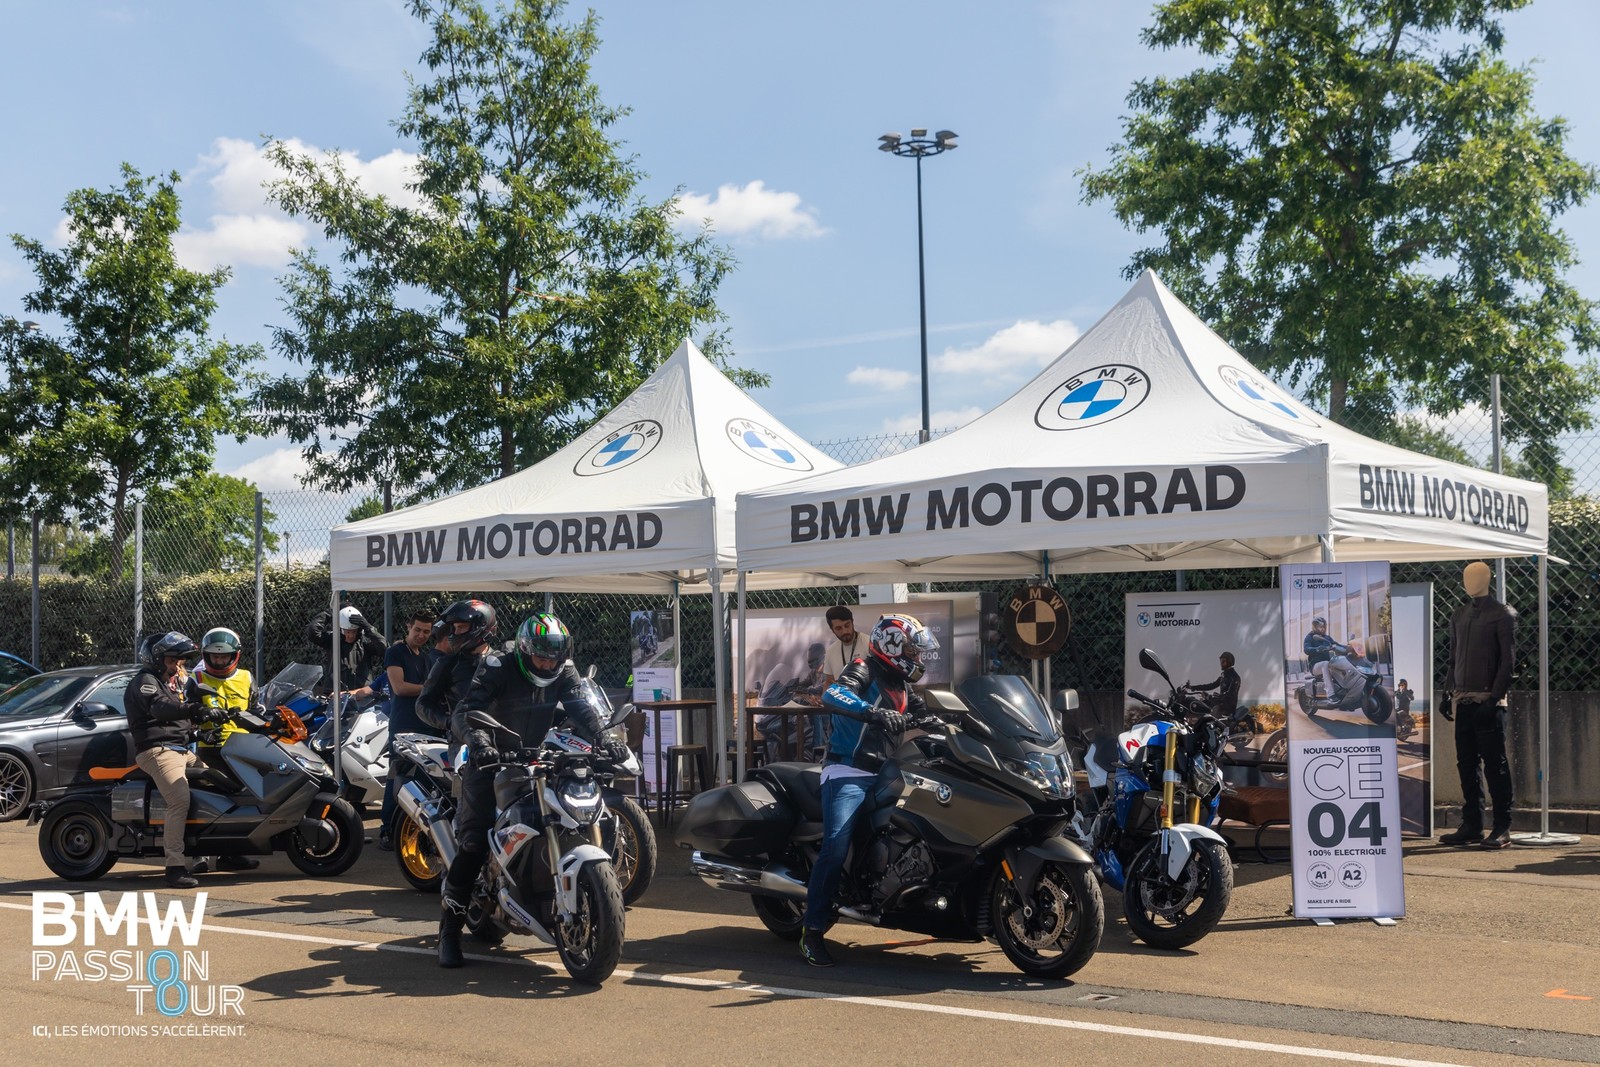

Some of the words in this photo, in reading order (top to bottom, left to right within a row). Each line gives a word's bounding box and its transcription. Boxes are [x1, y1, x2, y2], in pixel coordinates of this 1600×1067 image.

[1065, 368, 1142, 391] BMW
[607, 423, 658, 443] BMW
[730, 421, 777, 438] BMW
[790, 493, 910, 543] BMW
[926, 465, 1246, 531] MOTORRAD
[1359, 464, 1416, 515] BMW
[1422, 475, 1529, 533] MOTORRAD
[366, 529, 447, 568] BMW
[457, 512, 663, 561] MOTORRAD
[1010, 588, 1063, 612] BMW
[1154, 611, 1175, 619] BMW
[1154, 618, 1200, 627] MOTORRAD
[1303, 746, 1342, 755] NOUVEAU
[1343, 745, 1381, 754] SCOOTER
[1303, 754, 1384, 801] CE
[1307, 802, 1388, 848] 04
[1308, 849, 1331, 857] 100%
[1334, 848, 1387, 856] ELECTRIQUE
[1315, 870, 1327, 879] A1
[1343, 869, 1362, 880] A2
